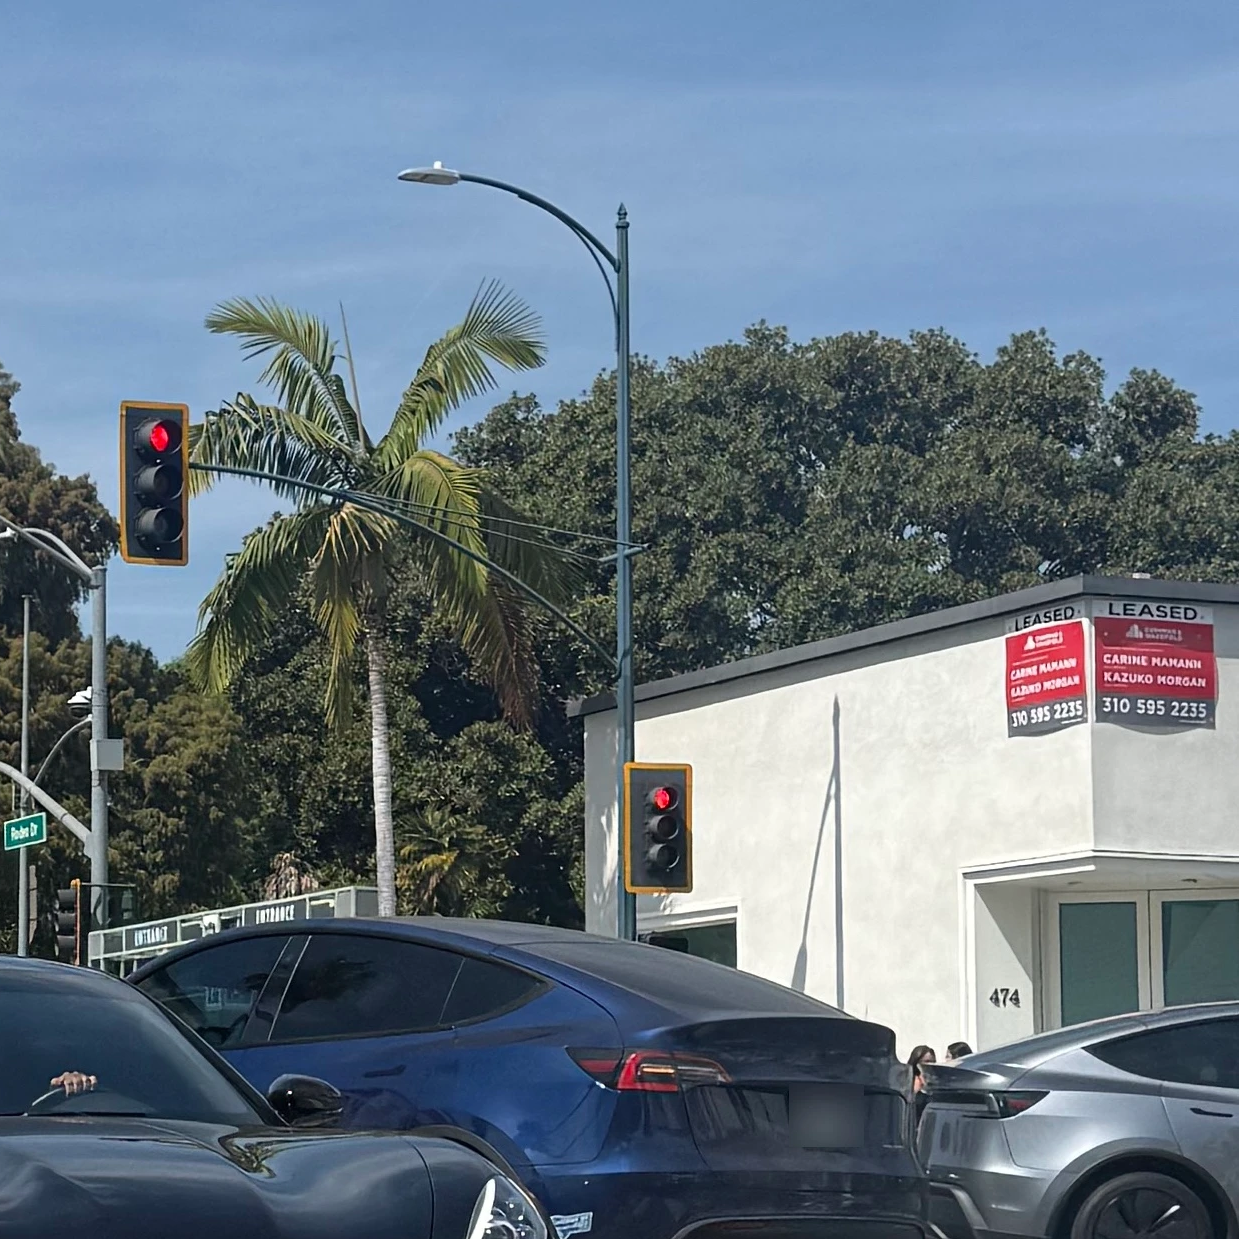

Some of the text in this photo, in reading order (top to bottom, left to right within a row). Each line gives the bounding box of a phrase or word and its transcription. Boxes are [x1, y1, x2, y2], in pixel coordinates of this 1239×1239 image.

[1015, 606, 1075, 632] LEASED
[1108, 602, 1198, 621] LEASED
[1103, 653, 1149, 666] CARINE
[1103, 671, 1207, 687] KAZUKO MORGAN
[1011, 700, 1083, 728] 310 595 2235
[1102, 697, 1207, 718] 310 595 2235
[989, 987, 1021, 1008] 474
